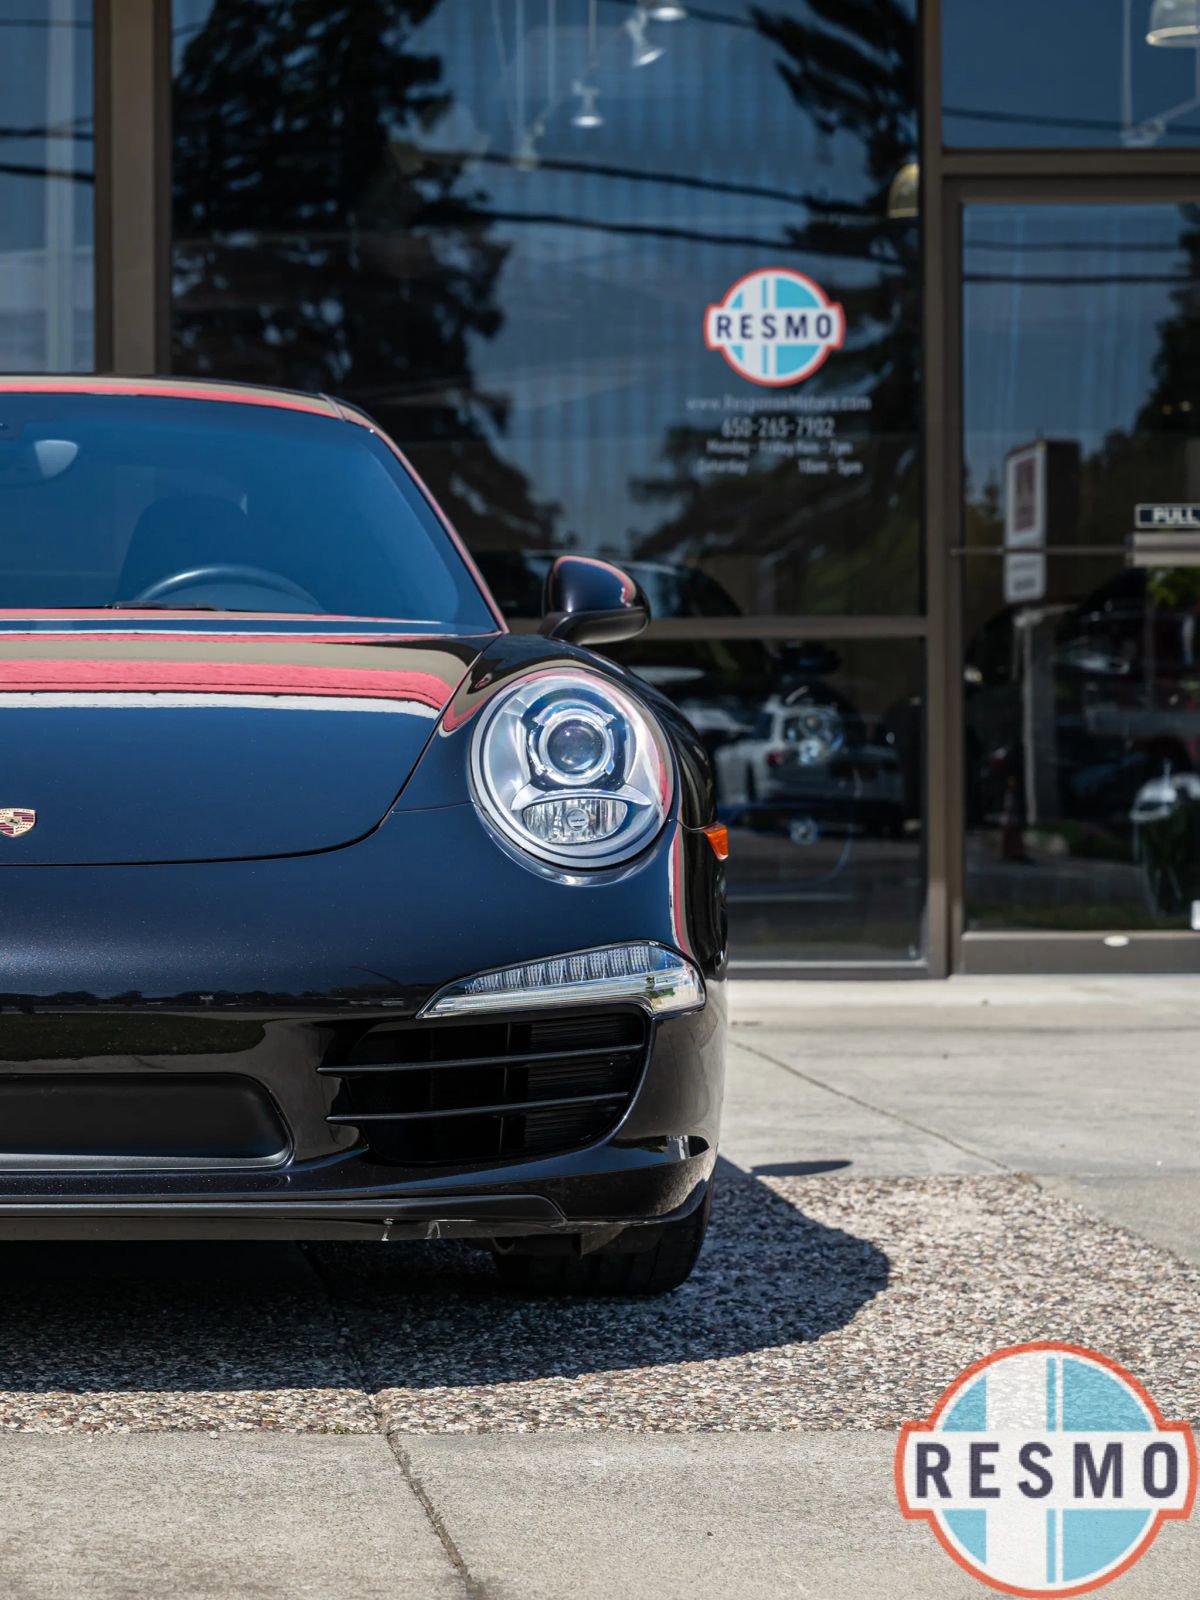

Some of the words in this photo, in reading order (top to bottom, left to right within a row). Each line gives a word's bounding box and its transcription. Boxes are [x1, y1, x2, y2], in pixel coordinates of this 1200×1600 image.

[716, 314, 832, 339] RESMO
[721, 416, 836, 438] 650-265-7902
[1153, 507, 1198, 524] PULL
